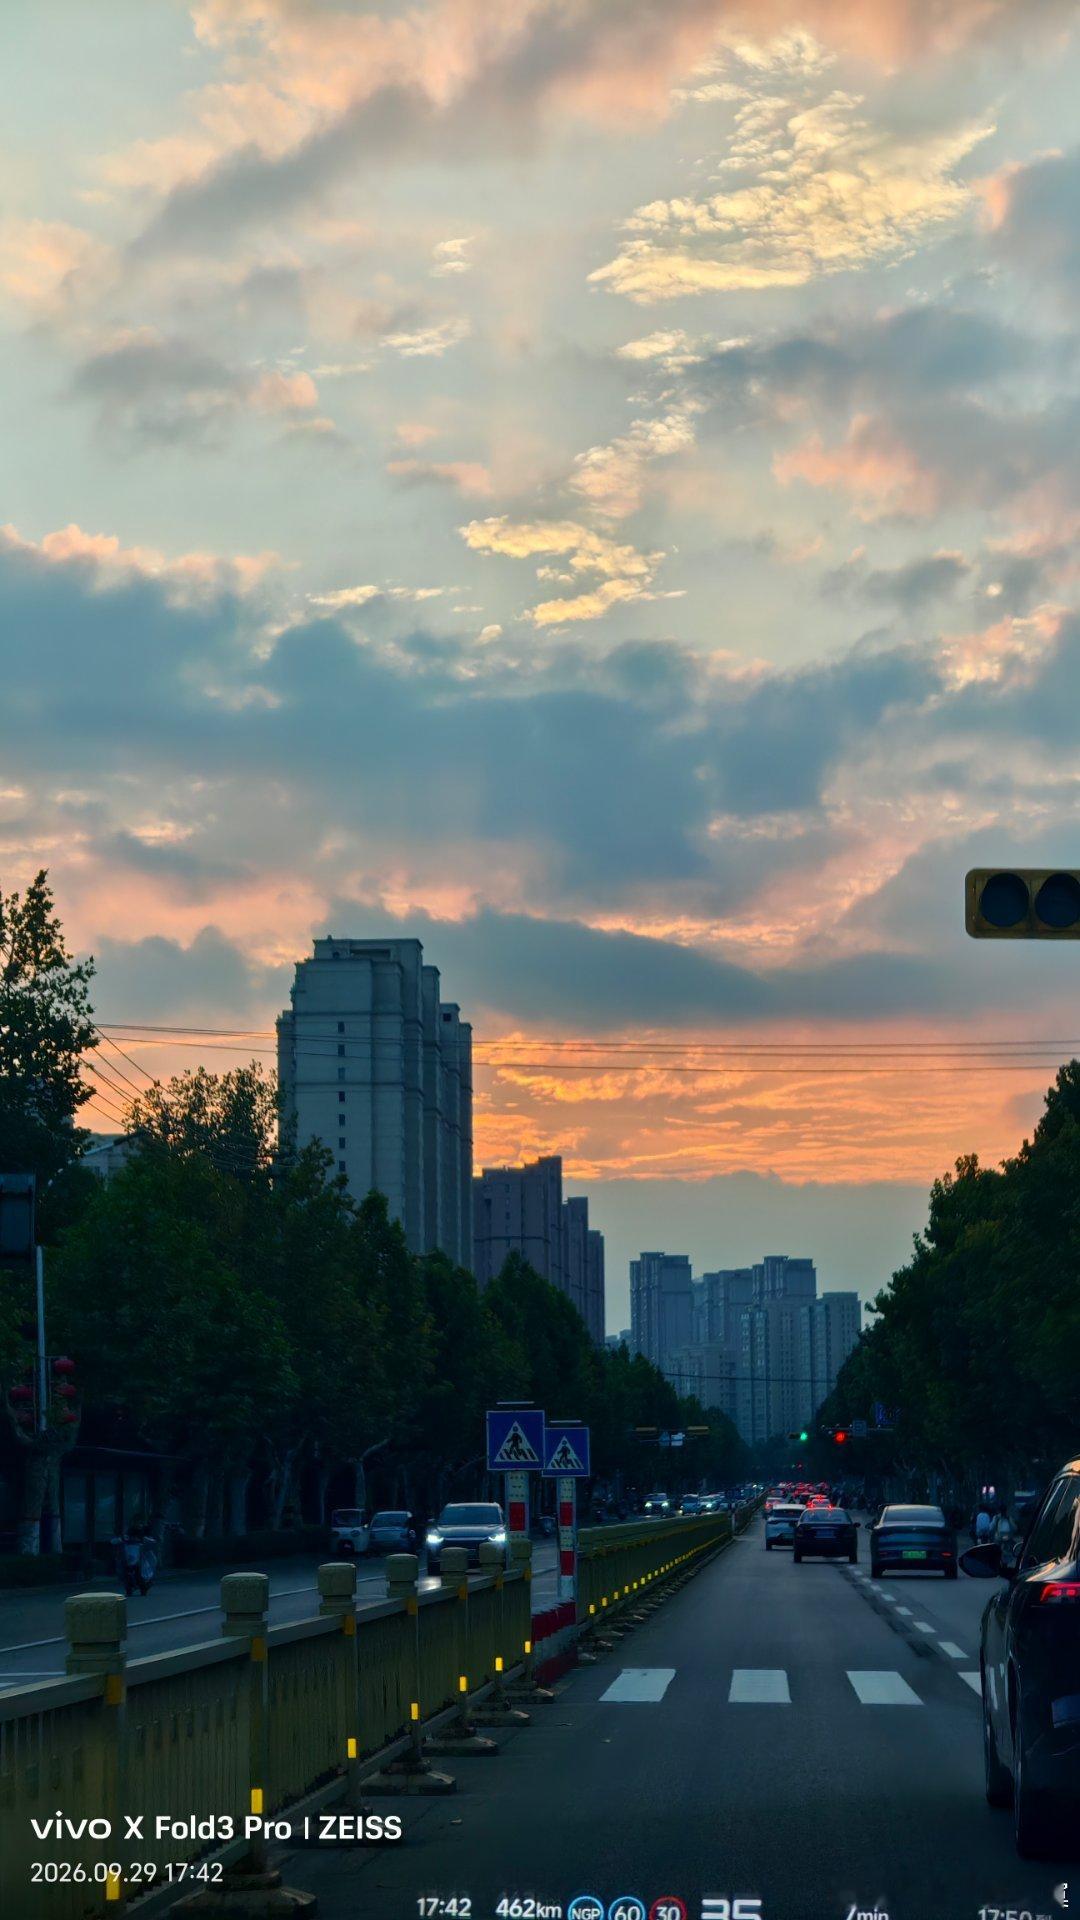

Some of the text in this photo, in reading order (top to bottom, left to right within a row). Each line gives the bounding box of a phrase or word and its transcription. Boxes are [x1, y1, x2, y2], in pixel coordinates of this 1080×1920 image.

[416, 1898, 472, 1917] 17:42
[495, 1898, 562, 1918] 462km
[572, 1908, 600, 1920] NGP
[614, 1906, 641, 1920] 60
[656, 1906, 680, 1920] 30
